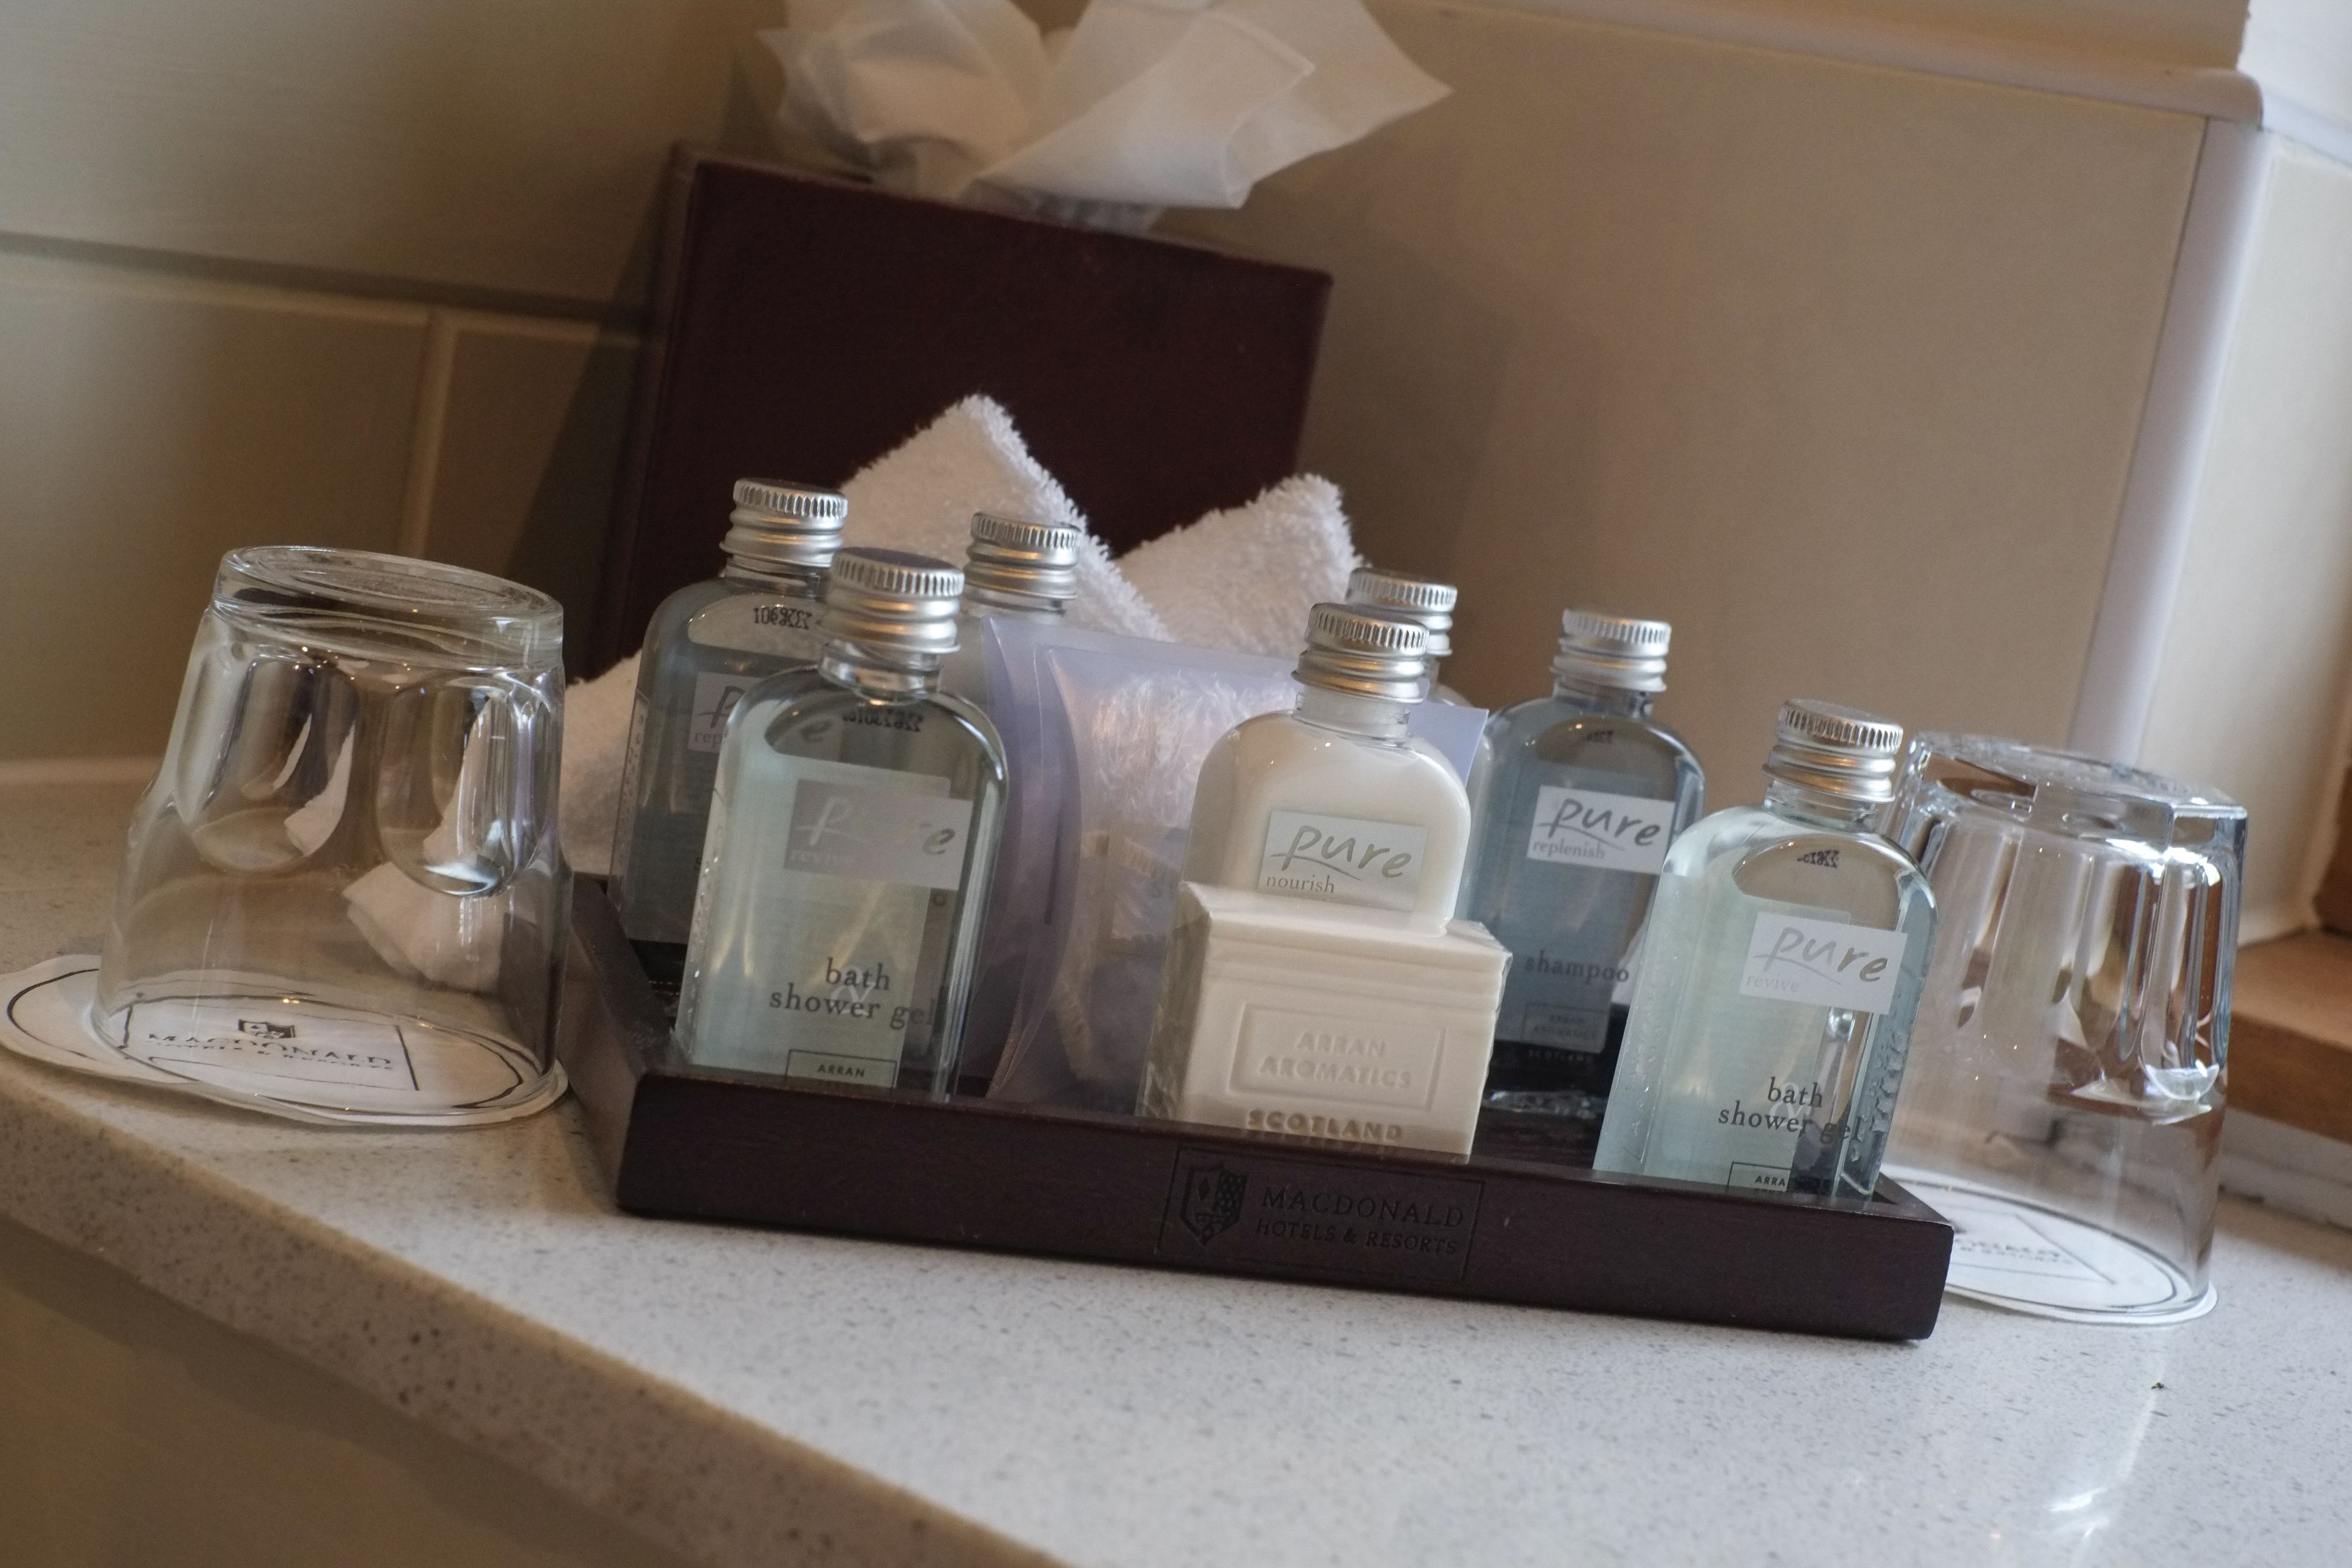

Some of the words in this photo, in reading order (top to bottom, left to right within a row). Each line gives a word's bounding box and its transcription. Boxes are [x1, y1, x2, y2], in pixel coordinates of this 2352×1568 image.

[1539, 797, 1661, 851] pure
[1271, 824, 1412, 881] pure
[1532, 839, 1605, 859] replenish
[1266, 873, 1335, 894] nourish
[1524, 949, 1630, 986] shampoo
[1753, 926, 1888, 985] pure
[825, 957, 891, 991] bath
[1745, 976, 1800, 993] revive
[769, 982, 881, 1019] shower
[1295, 1031, 1386, 1058] ARRAN
[818, 1063, 865, 1078] ARRAN
[1259, 1055, 1412, 1088] AROMATICS
[1767, 1076, 1823, 1109] bath
[1248, 1109, 1403, 1144] SCOTLAND
[1717, 1100, 1813, 1137] shower
[1754, 1175, 1787, 1187] ARRA
[1261, 1186, 1464, 1229] MACDONALD
[1256, 1218, 1335, 1242] HOTELS
[1343, 1230, 1357, 1245] &
[1365, 1231, 1458, 1255] RESORTS
